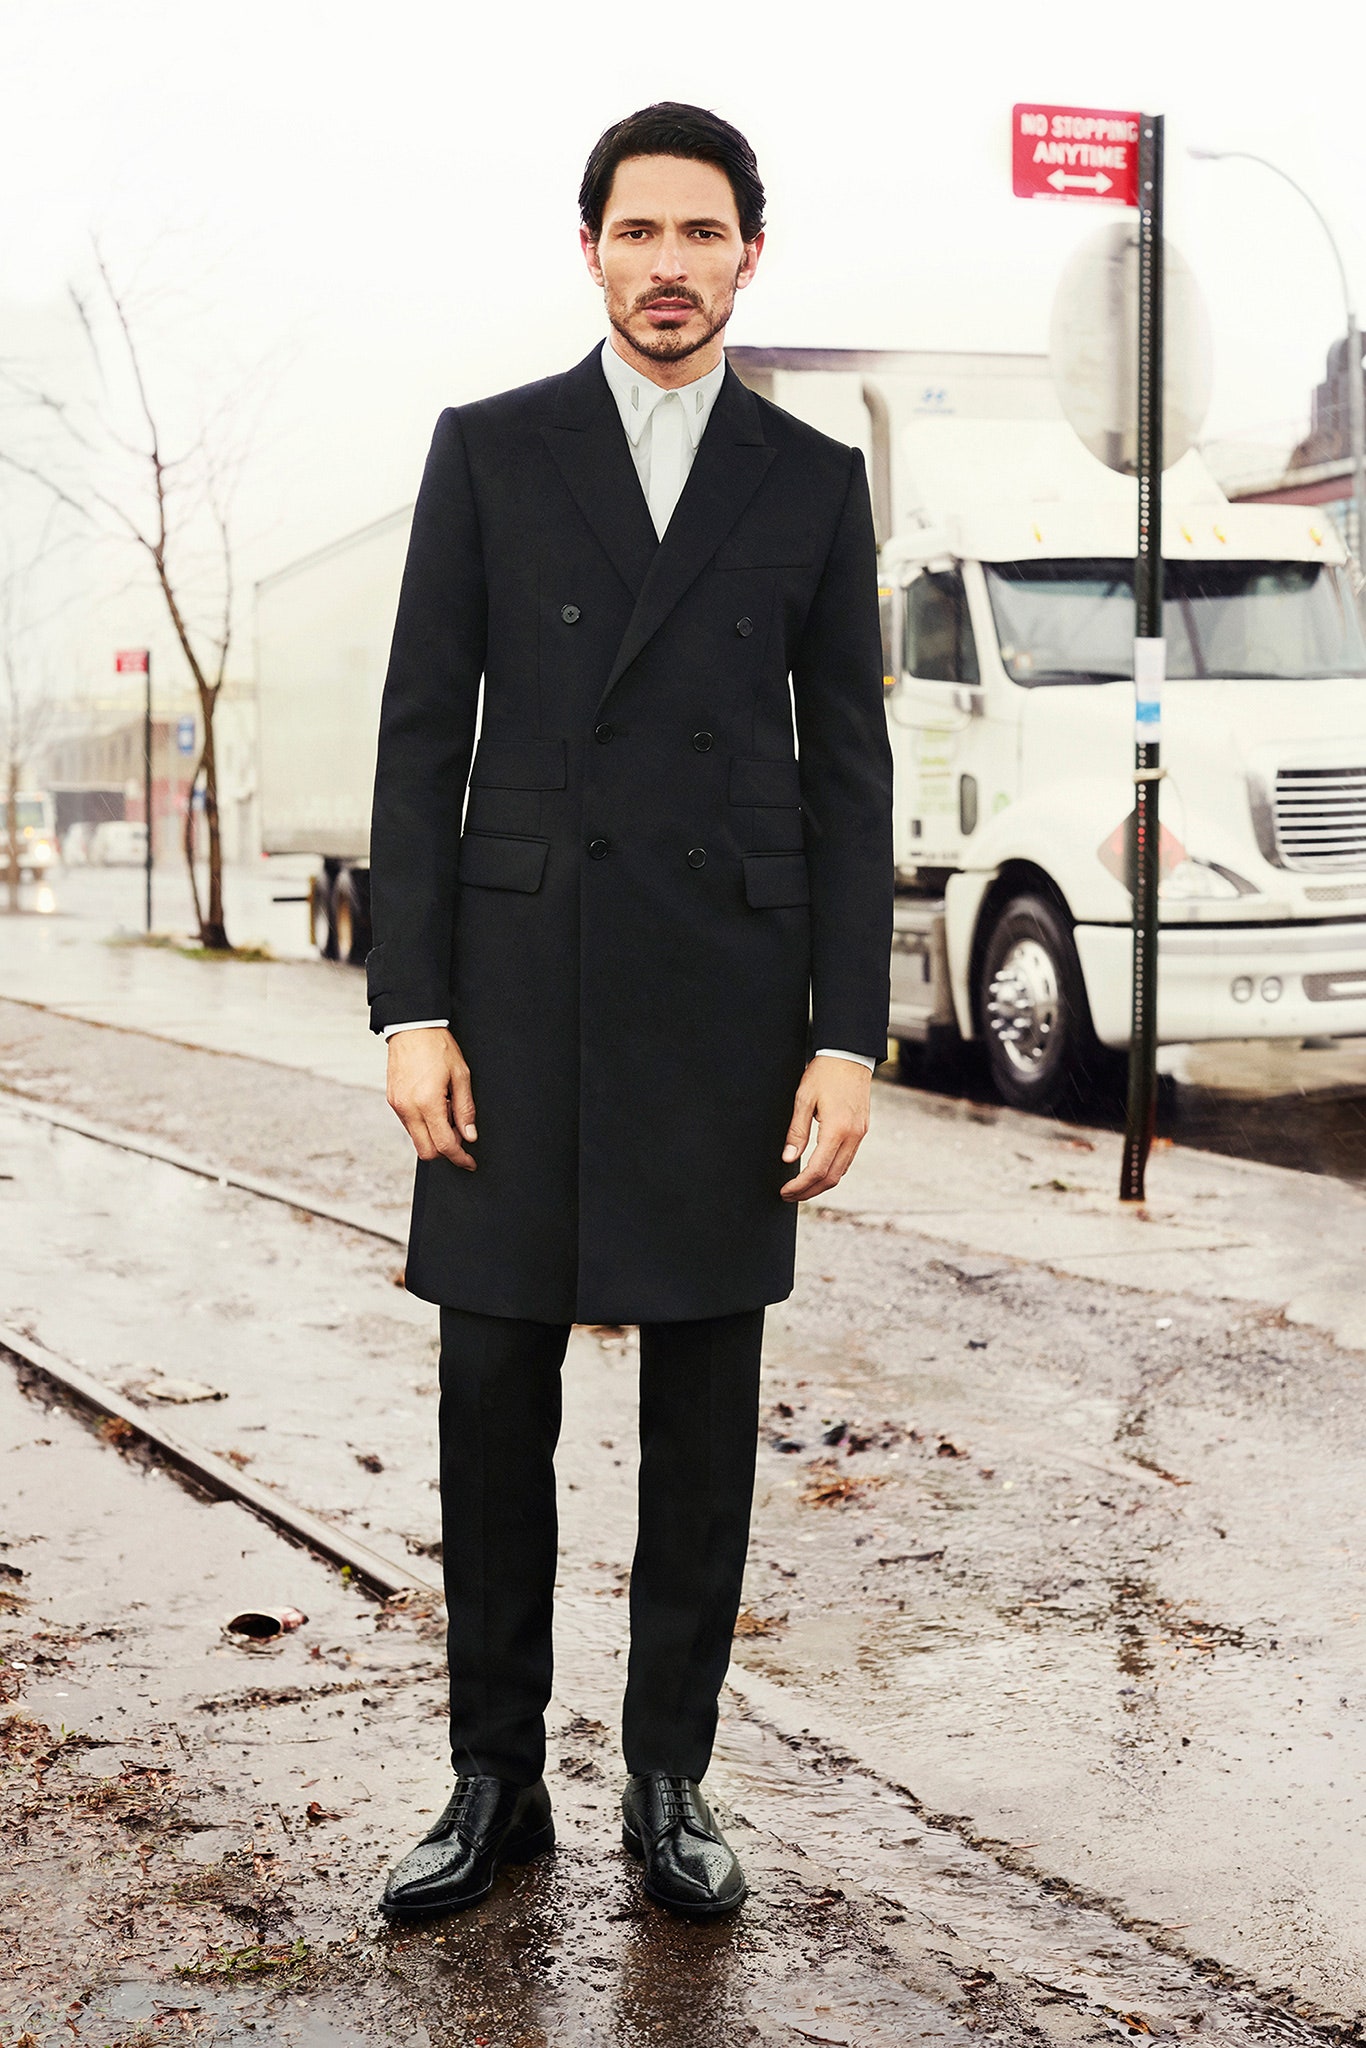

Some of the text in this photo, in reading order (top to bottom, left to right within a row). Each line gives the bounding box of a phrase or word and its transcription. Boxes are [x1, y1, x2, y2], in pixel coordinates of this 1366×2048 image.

[1020, 113, 1138, 142] NO STOPPING
[1033, 141, 1127, 169] ANYTIME
